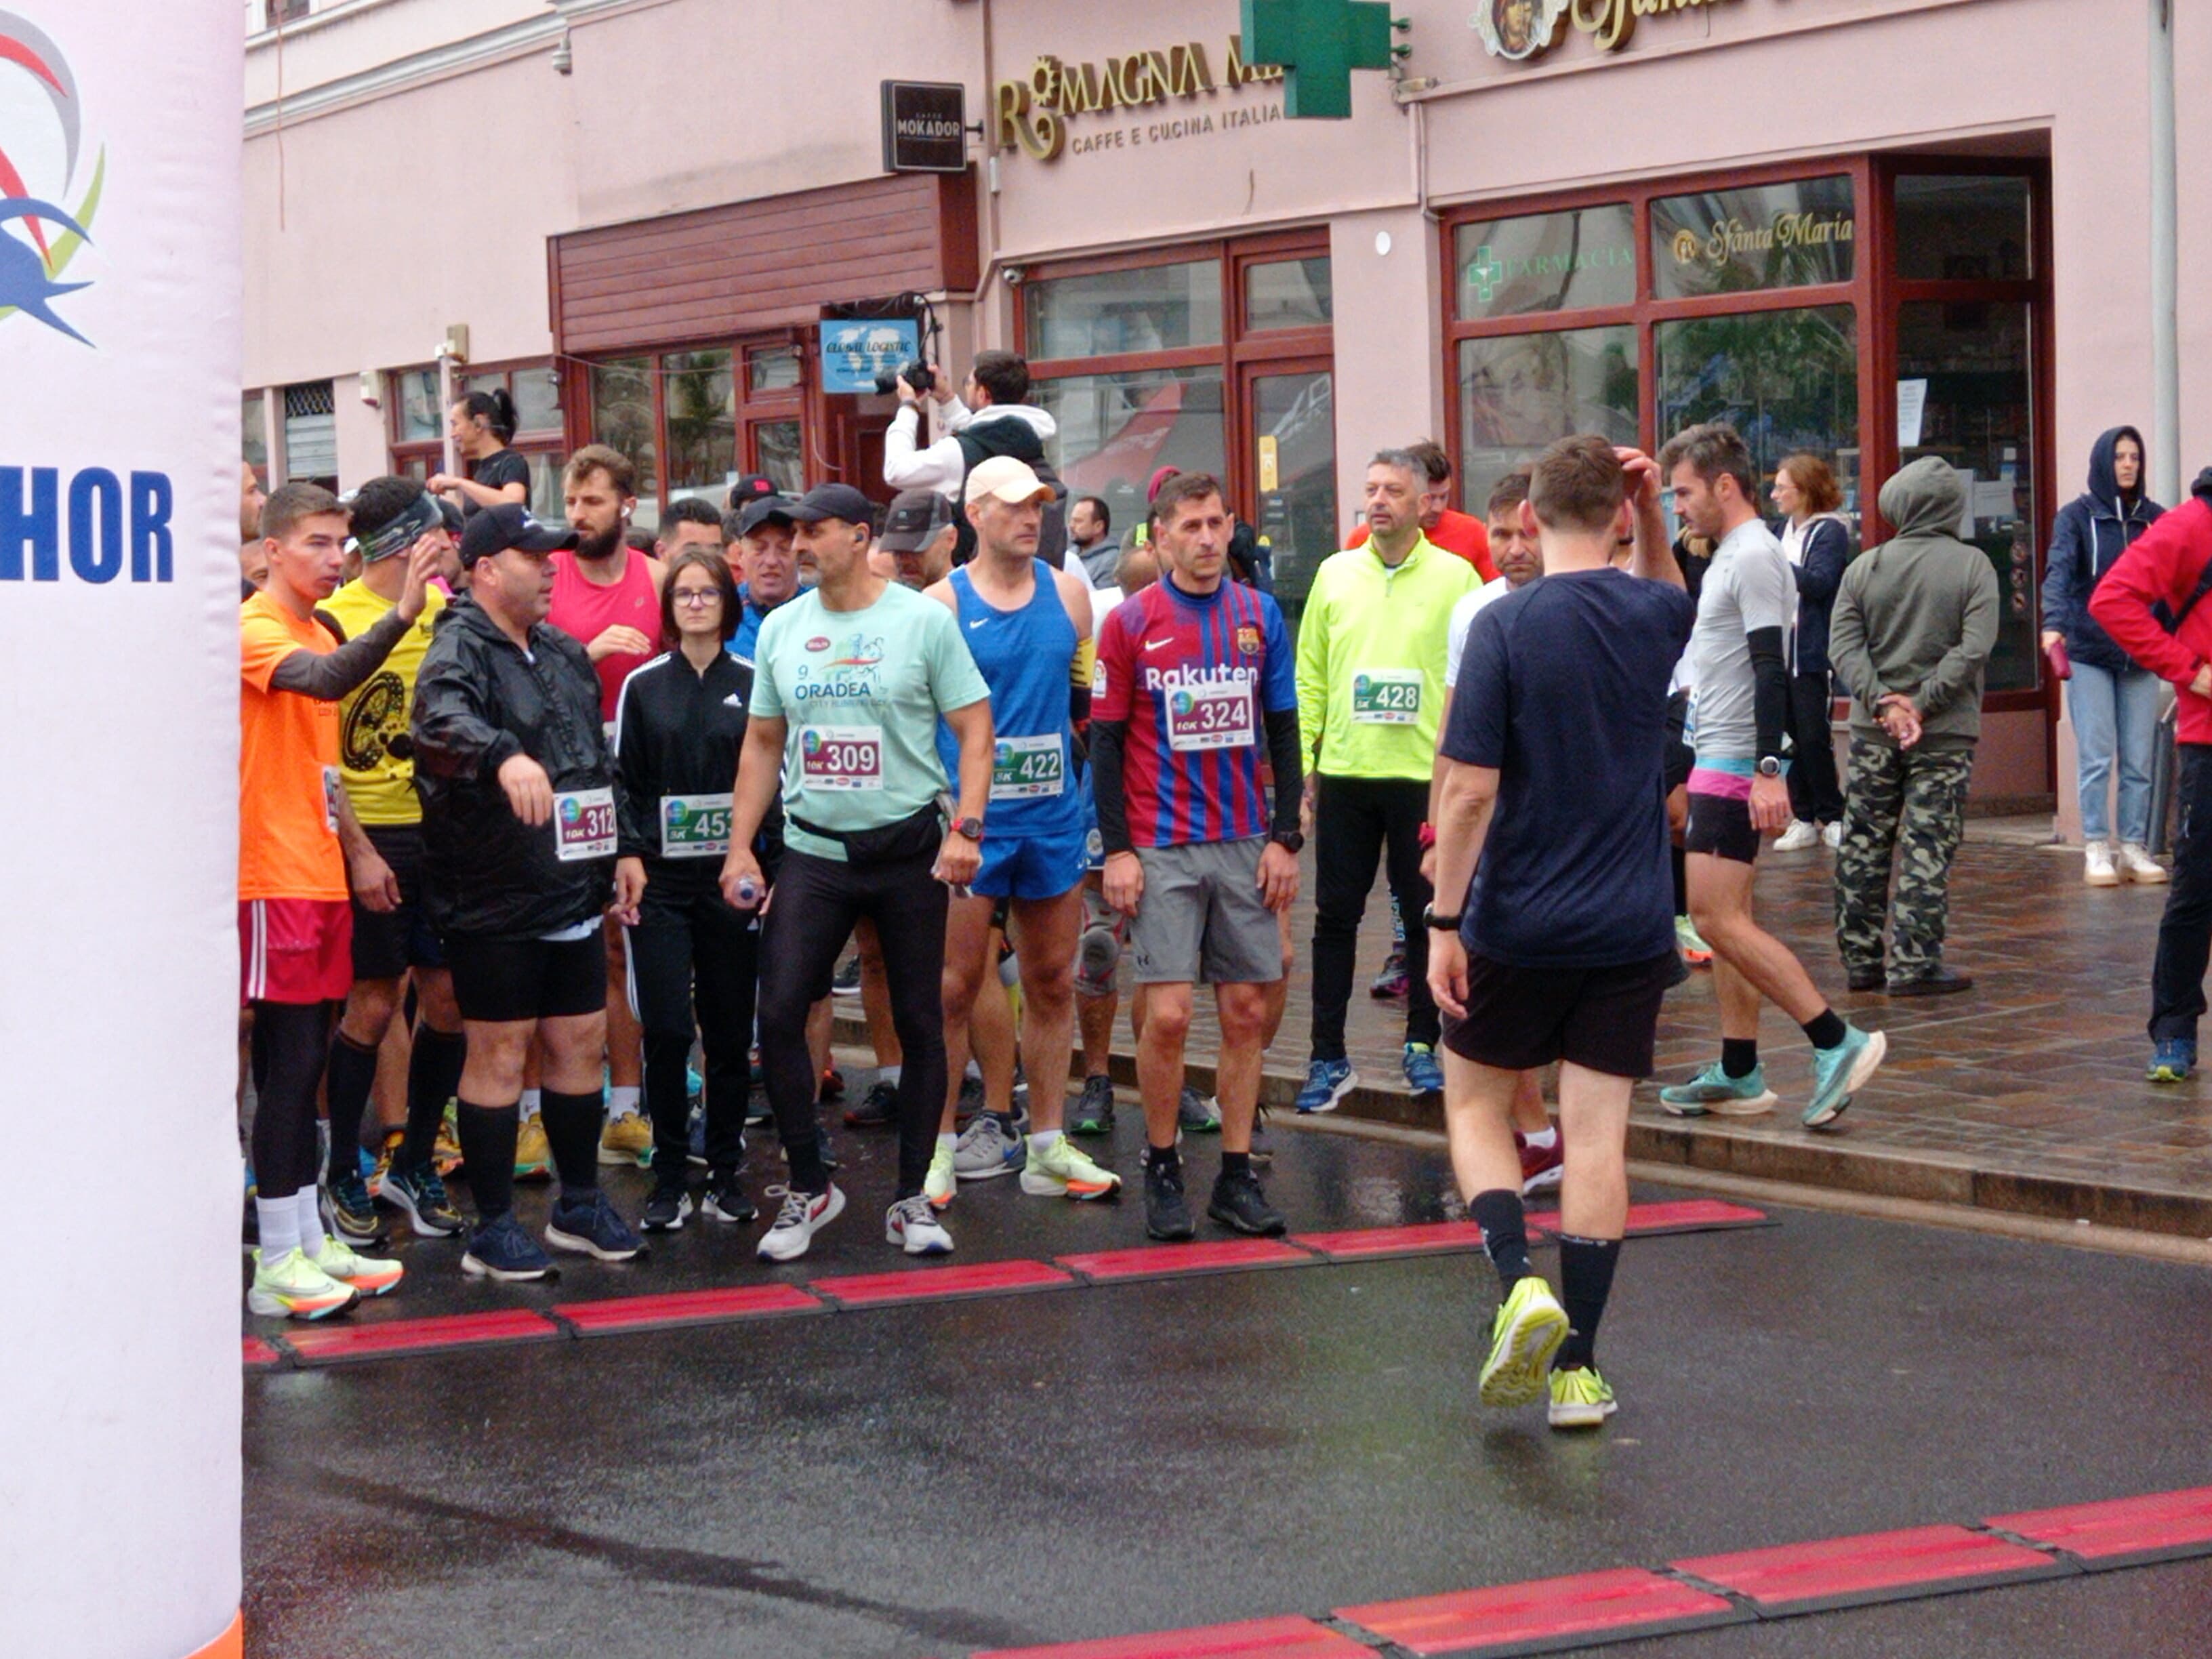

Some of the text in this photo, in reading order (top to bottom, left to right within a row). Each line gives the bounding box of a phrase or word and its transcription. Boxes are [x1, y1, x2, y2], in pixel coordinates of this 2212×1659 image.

[998, 42, 1206, 160] ROMAGNA
[897, 119, 960, 136] MOKADOR
[1072, 130, 1123, 155] CAFFE
[1130, 127, 1141, 146] E
[1149, 114, 1214, 142] CUCINA
[1776, 211, 1853, 249] Maria
[1507, 247, 1633, 279] FARMACIA
[865, 341, 912, 353] LOGISTIC
[0, 466, 173, 584] HOR
[795, 682, 871, 700] ORADEA
[1145, 663, 1258, 691] Rakuten
[1376, 684, 1417, 709] 428
[1200, 699, 1248, 730] 324
[827, 744, 876, 772] 309
[1019, 752, 1059, 779] 422
[586, 807, 615, 838] 312
